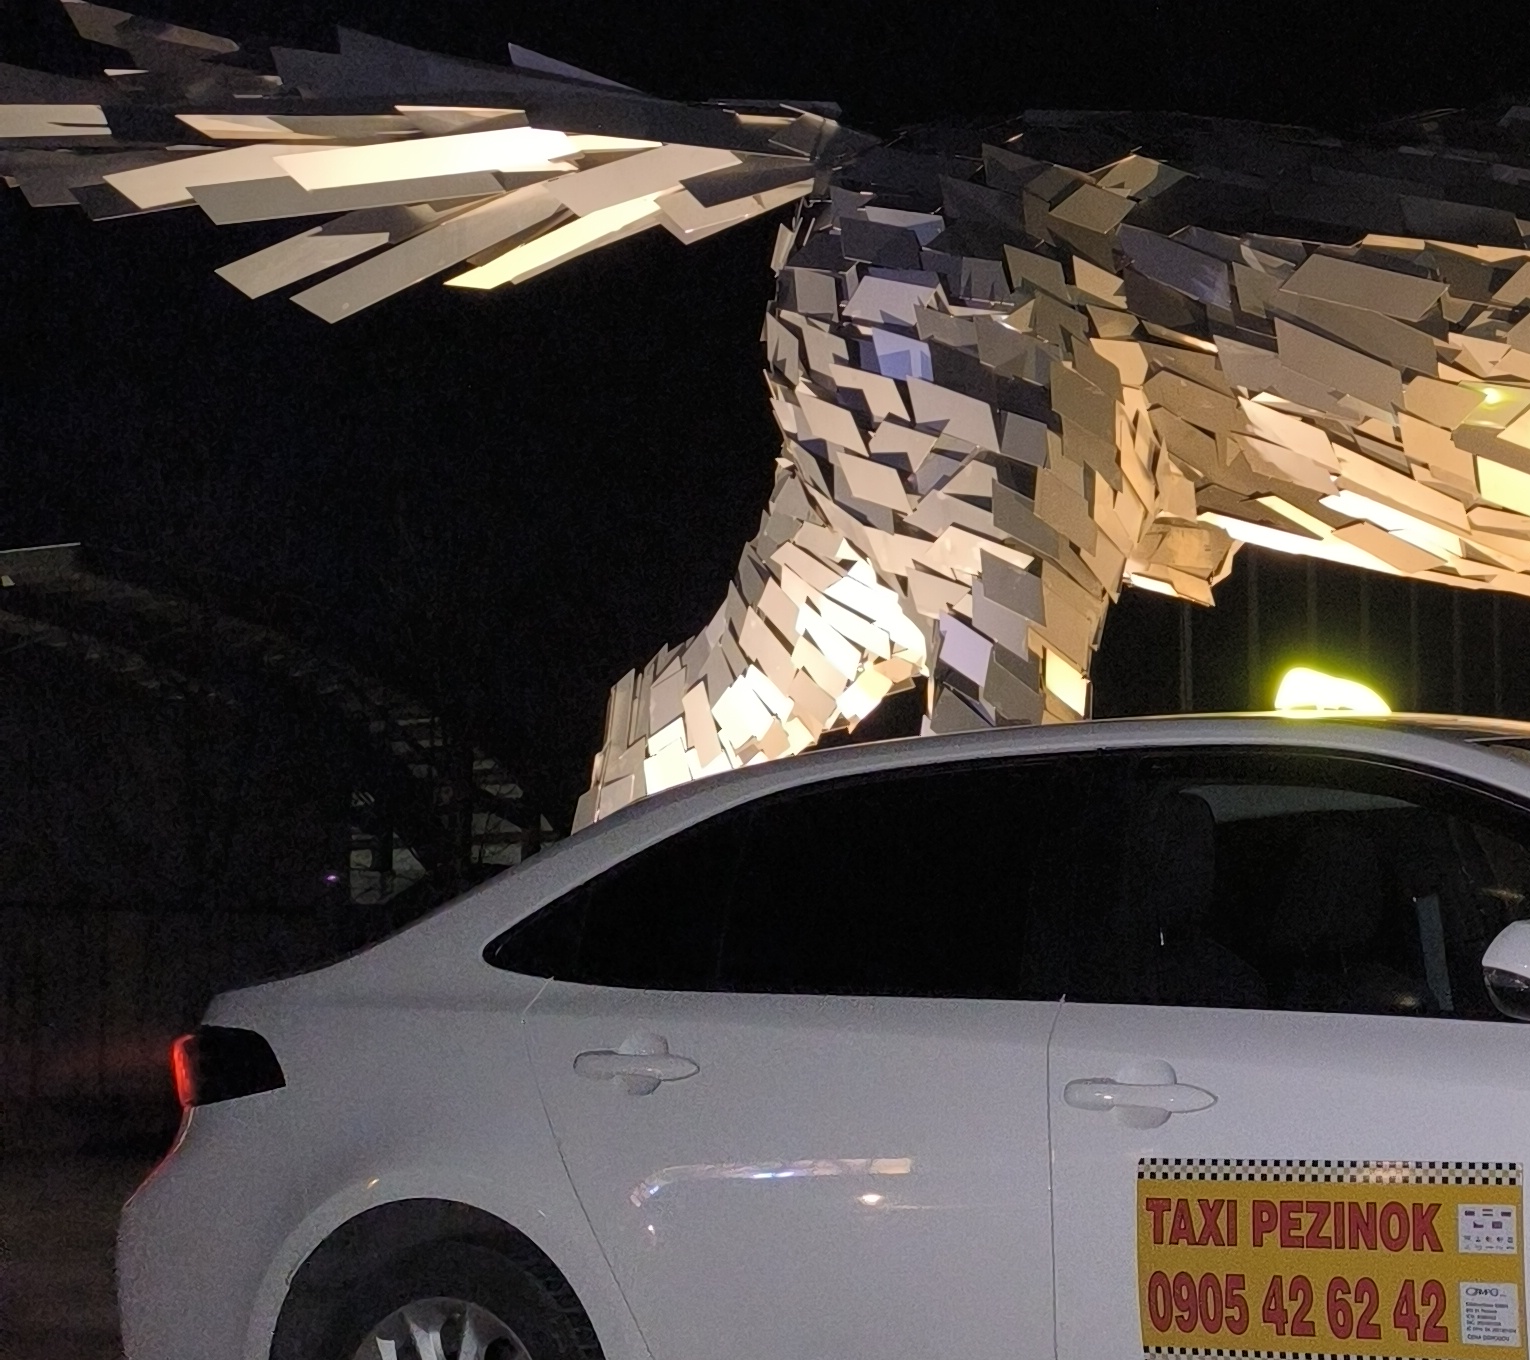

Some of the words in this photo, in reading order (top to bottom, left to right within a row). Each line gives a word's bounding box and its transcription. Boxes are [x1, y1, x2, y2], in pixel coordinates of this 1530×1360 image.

[1145, 1197, 1238, 1247] TAXI
[1252, 1199, 1445, 1253] PEZINOK
[1147, 1270, 1250, 1335] 0905
[1261, 1274, 1316, 1337] 42
[1326, 1276, 1382, 1340] 62
[1392, 1279, 1449, 1343] 42
